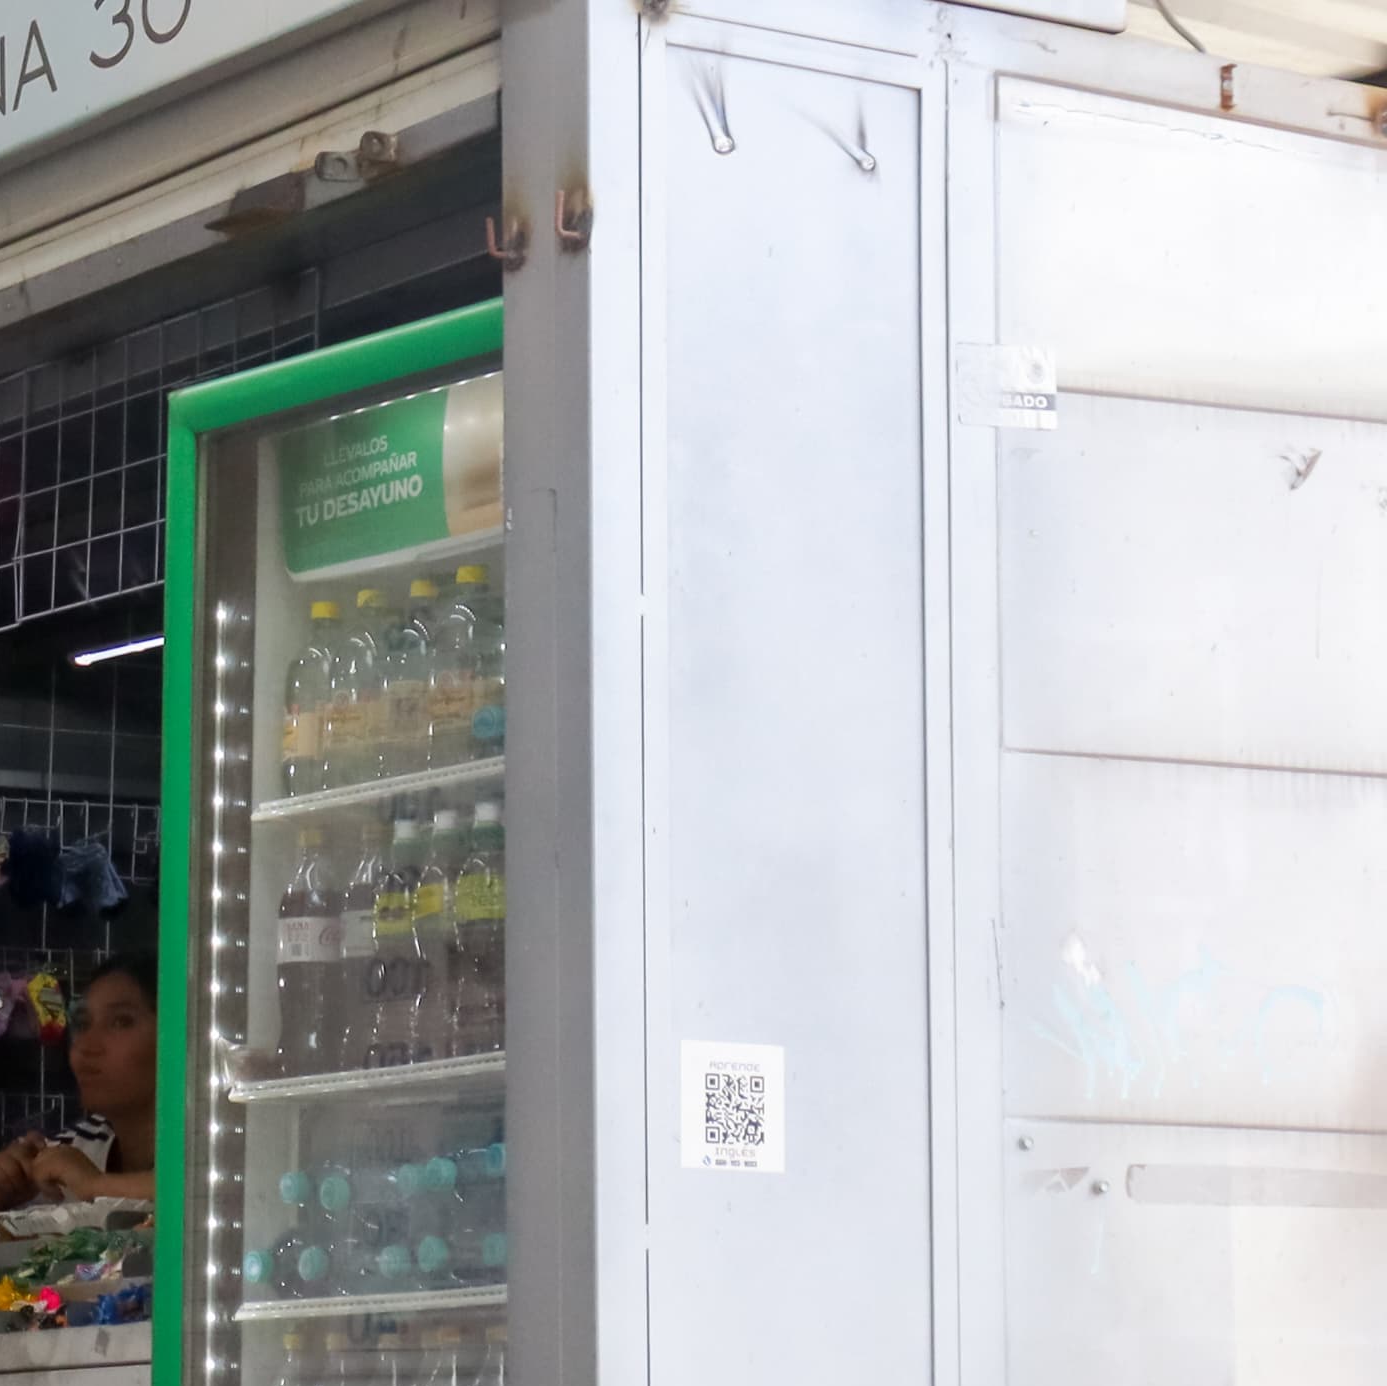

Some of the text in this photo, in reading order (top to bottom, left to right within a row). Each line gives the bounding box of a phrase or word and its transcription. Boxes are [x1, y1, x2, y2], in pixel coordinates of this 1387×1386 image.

[298, 450, 418, 498] PARA ACOMPAÑAR
[295, 473, 424, 528] TU DESAYUNO
